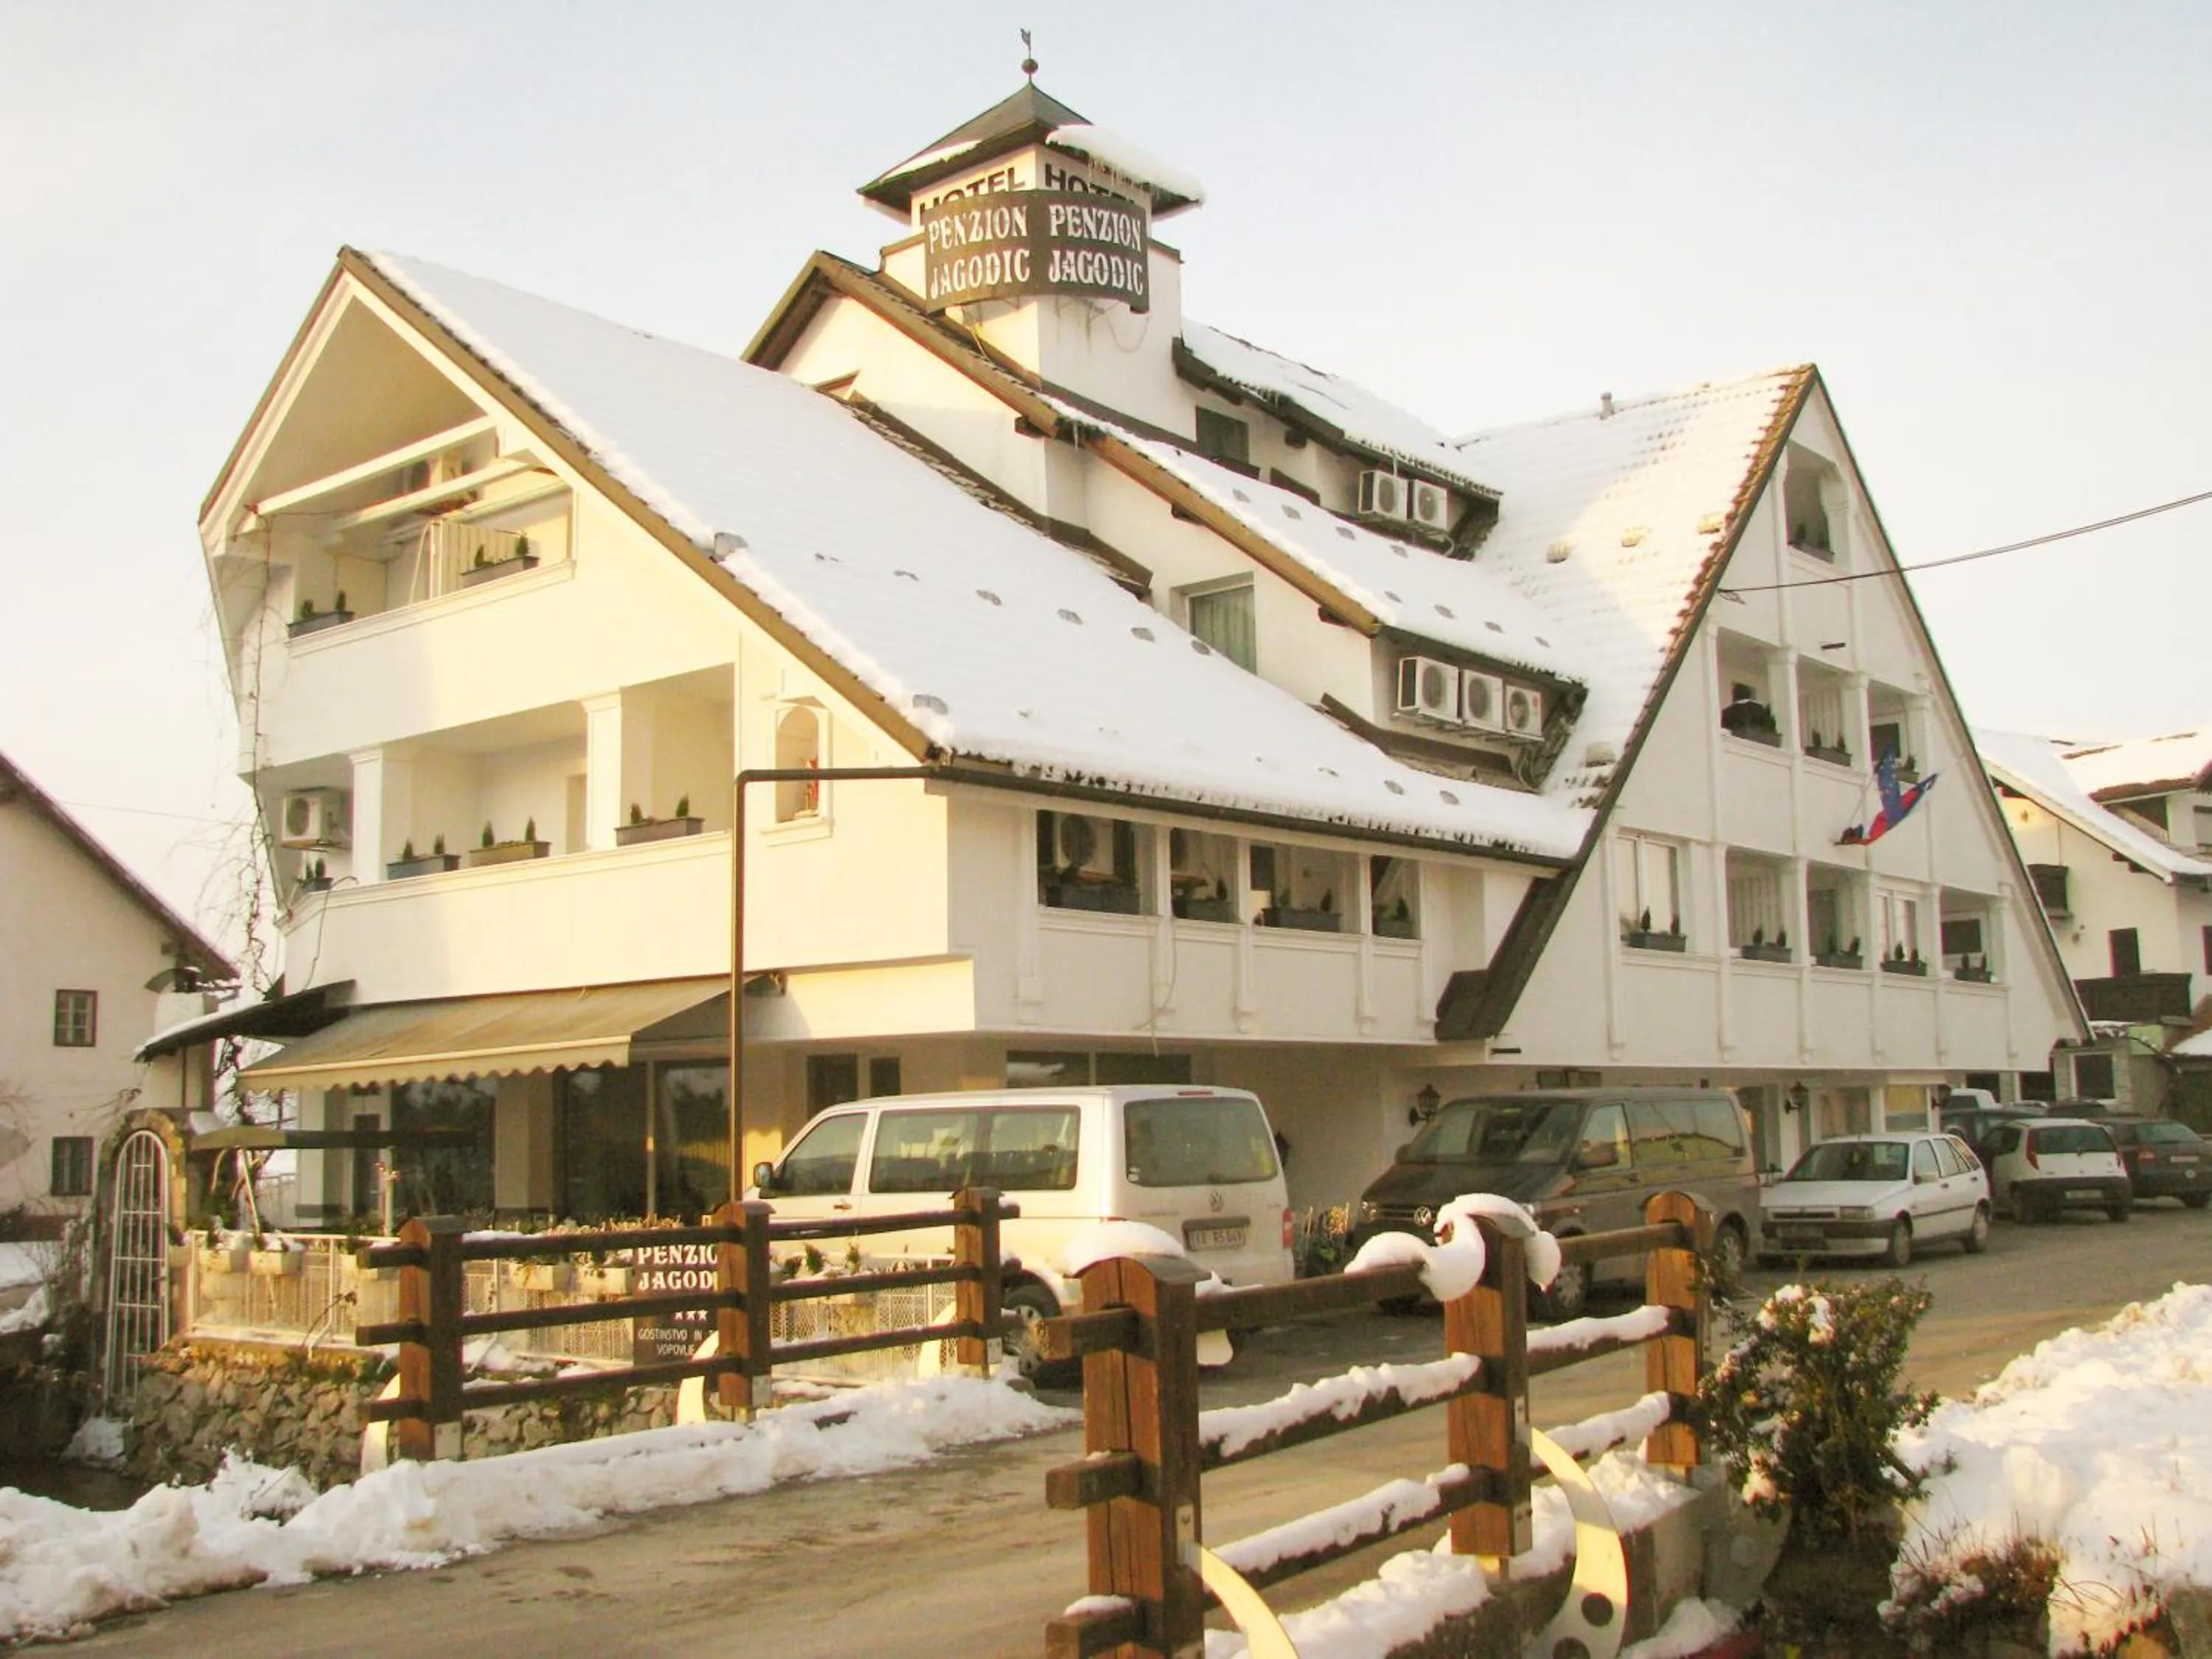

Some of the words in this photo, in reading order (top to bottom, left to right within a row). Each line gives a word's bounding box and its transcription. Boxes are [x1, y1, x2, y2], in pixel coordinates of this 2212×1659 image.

[928, 205, 1028, 254] PENZION
[1048, 204, 1142, 252] PENZION
[931, 248, 1030, 299] JAGODIC
[1048, 249, 1143, 296] JAGODIC
[638, 1244, 718, 1265] PENZIO
[638, 1270, 719, 1292] JAGODI
